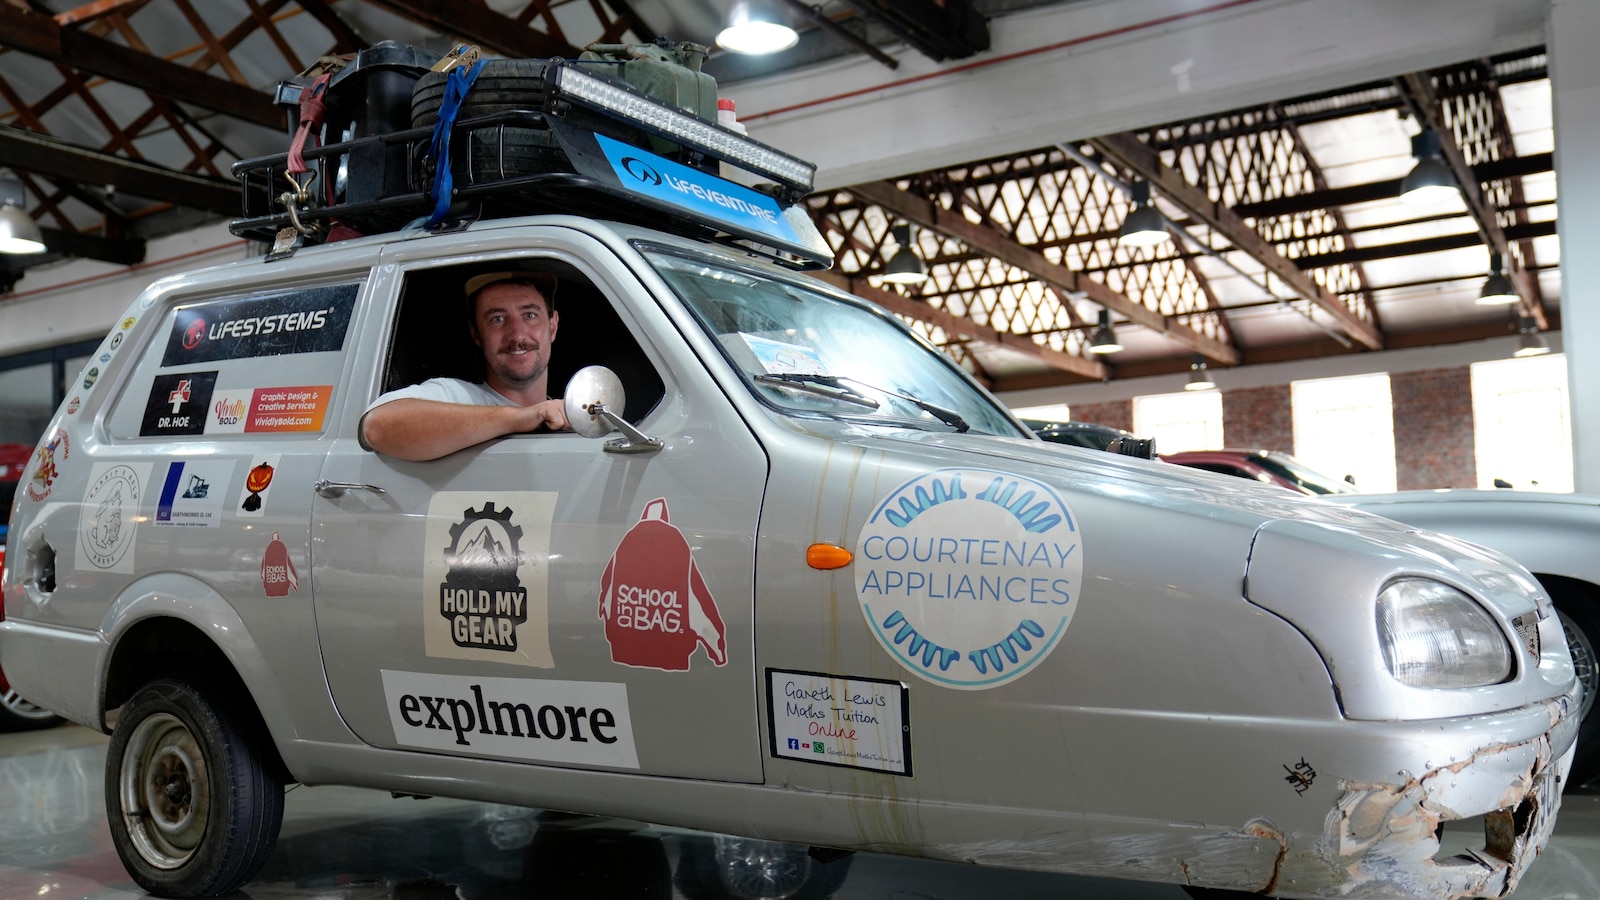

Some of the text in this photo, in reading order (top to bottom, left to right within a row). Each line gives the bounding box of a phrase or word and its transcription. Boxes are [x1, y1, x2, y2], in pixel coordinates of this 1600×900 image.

[258, 401, 317, 411] Creative Services
[260, 391, 319, 402] Graphic Design &
[215, 398, 246, 420] Vividly
[158, 416, 191, 428] DR. HOE
[219, 417, 238, 425] BOLD
[254, 416, 312, 427] VividlyBold.com
[863, 535, 1077, 569] COURTENAY
[272, 572, 287, 583] BAG
[861, 569, 1071, 606] APPLIANCES
[443, 588, 525, 617] HOLD MY
[617, 583, 682, 609] SCHOOL
[617, 602, 633, 616] in
[617, 606, 681, 633] a BAG
[453, 615, 515, 647] GEAR
[785, 681, 886, 707] Gareth Lewis
[399, 684, 618, 746] explmore
[786, 701, 879, 725] Maths Tuition
[808, 721, 858, 740] Online
